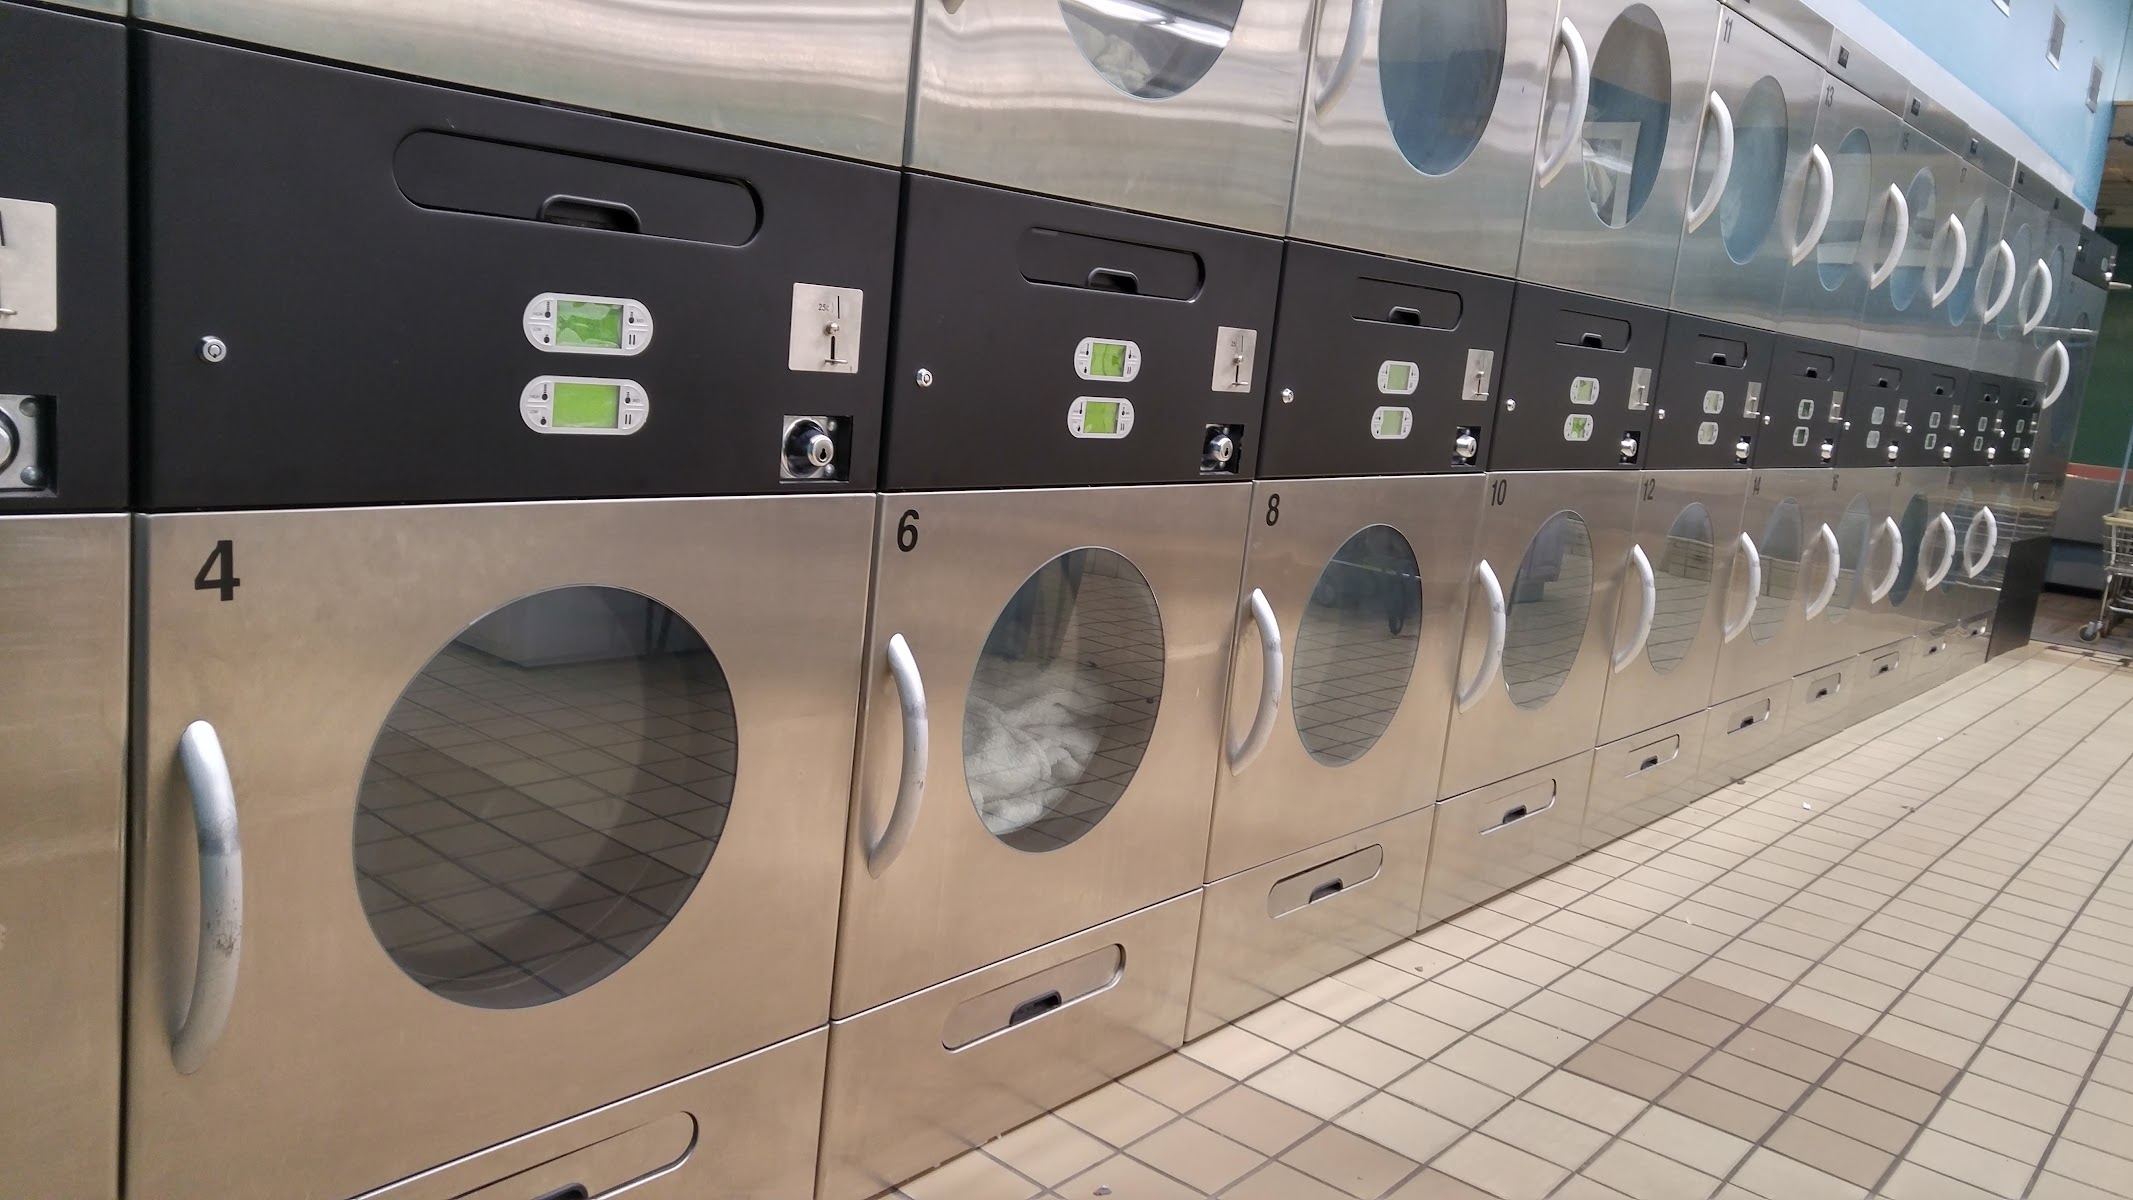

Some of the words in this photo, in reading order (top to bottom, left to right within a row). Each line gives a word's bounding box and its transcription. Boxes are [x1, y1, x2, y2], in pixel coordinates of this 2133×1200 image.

[1825, 84, 1834, 108] 13
[1491, 479, 1507, 506] 10
[1643, 478, 1656, 501] 12
[1752, 476, 1761, 495] 14
[1265, 493, 1280, 527] 8
[897, 509, 920, 553] 6
[194, 539, 241, 602] 4
